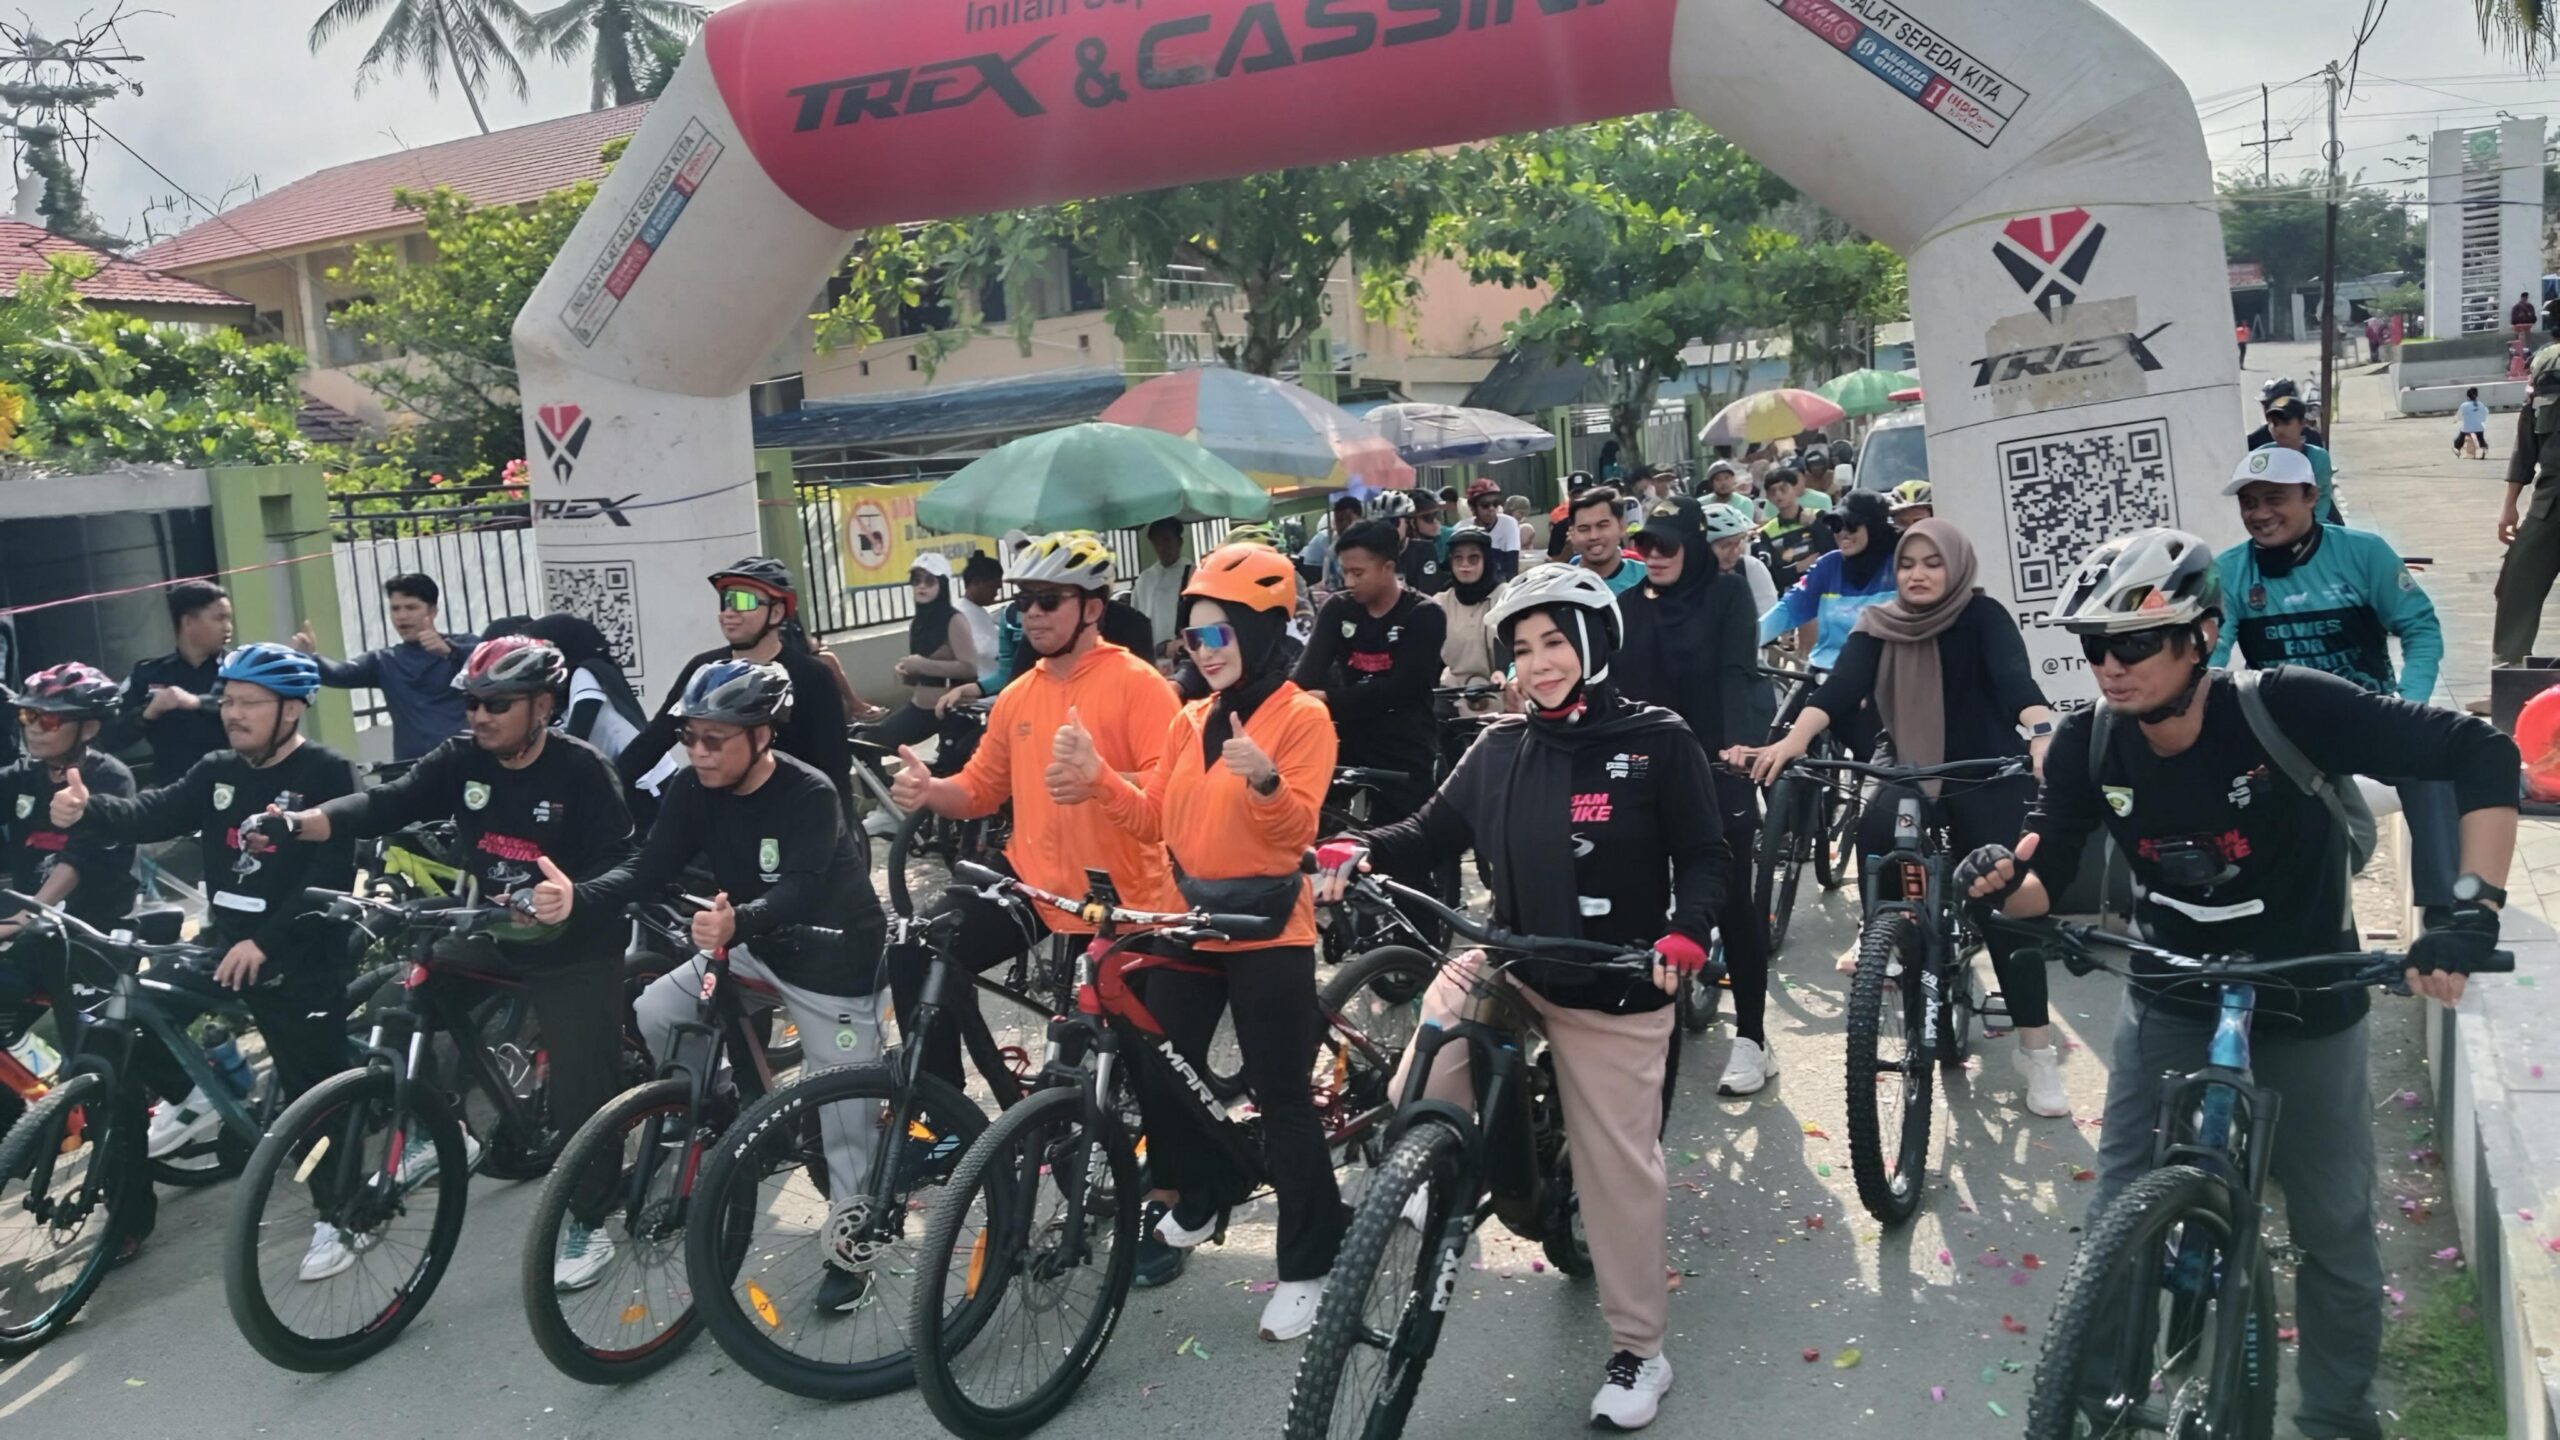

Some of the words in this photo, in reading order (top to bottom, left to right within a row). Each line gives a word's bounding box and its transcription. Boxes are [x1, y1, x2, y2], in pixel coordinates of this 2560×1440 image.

[785, 34, 1059, 134] TREX
[1074, 37, 1128, 108] &
[1895, 22, 1960, 77] SEPEDA
[1960, 66, 2003, 103] KITA
[2264, 619, 2343, 641] GOWES
[2284, 638, 2327, 656] FOR
[2041, 656, 2087, 675] @Tr
[1158, 1040, 1227, 1122] MARS
